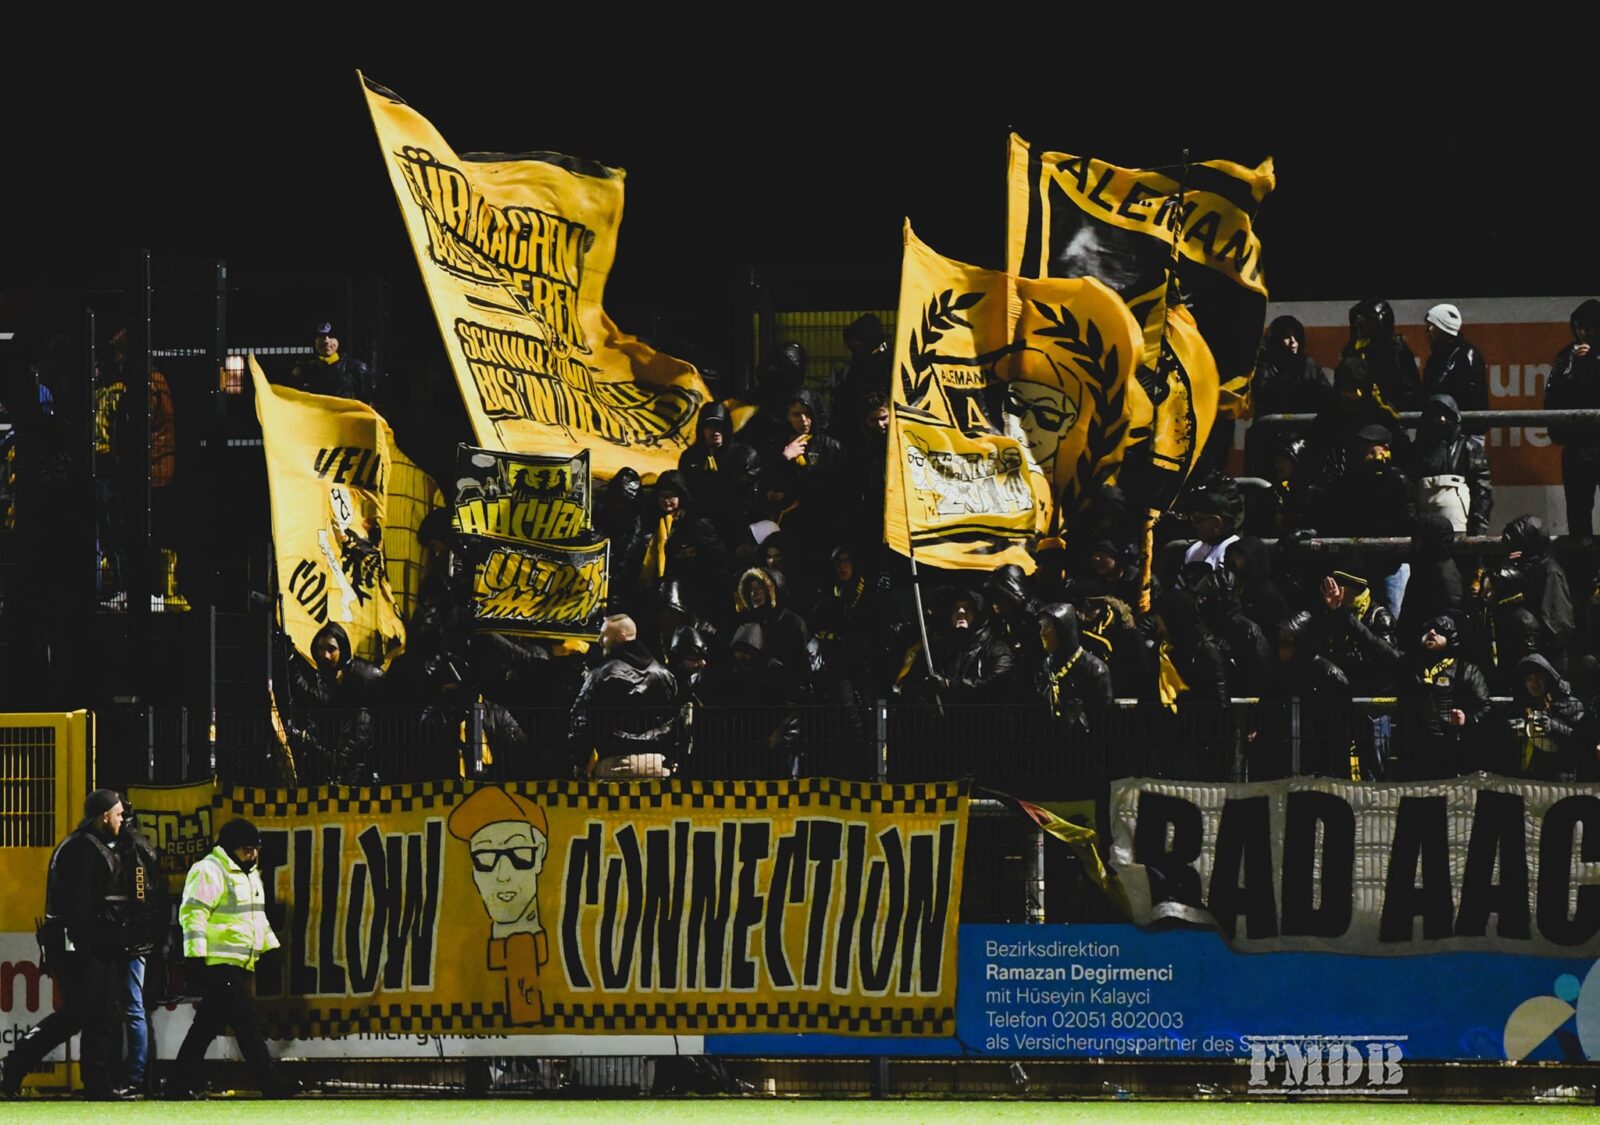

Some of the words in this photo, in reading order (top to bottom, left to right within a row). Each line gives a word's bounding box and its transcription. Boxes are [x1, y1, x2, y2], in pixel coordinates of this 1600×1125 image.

[474, 204, 585, 289] AACHEN
[469, 362, 520, 415] BIS
[523, 374, 557, 424] IN
[458, 499, 583, 540] AACHEN
[484, 551, 605, 600] ULTRAS
[1135, 791, 1357, 939] BAD
[254, 817, 446, 999] ELLOW
[557, 817, 959, 997] CONNECTION
[986, 940, 1119, 958] Bezirksdirektion
[986, 964, 1066, 981] Ramazan
[1071, 964, 1173, 984] Degirmenci
[986, 989, 1011, 1004] mit
[1017, 988, 1085, 1009] Hüseyin
[1091, 988, 1150, 1009] Kalayci
[986, 1011, 1047, 1028] Telefon
[1052, 1011, 1106, 1028] 02051
[1111, 1011, 1184, 1029] 802003
[986, 1034, 1009, 1050] als
[1014, 1034, 1197, 1054] Versicherungspartner
[1202, 1035, 1234, 1051] des
